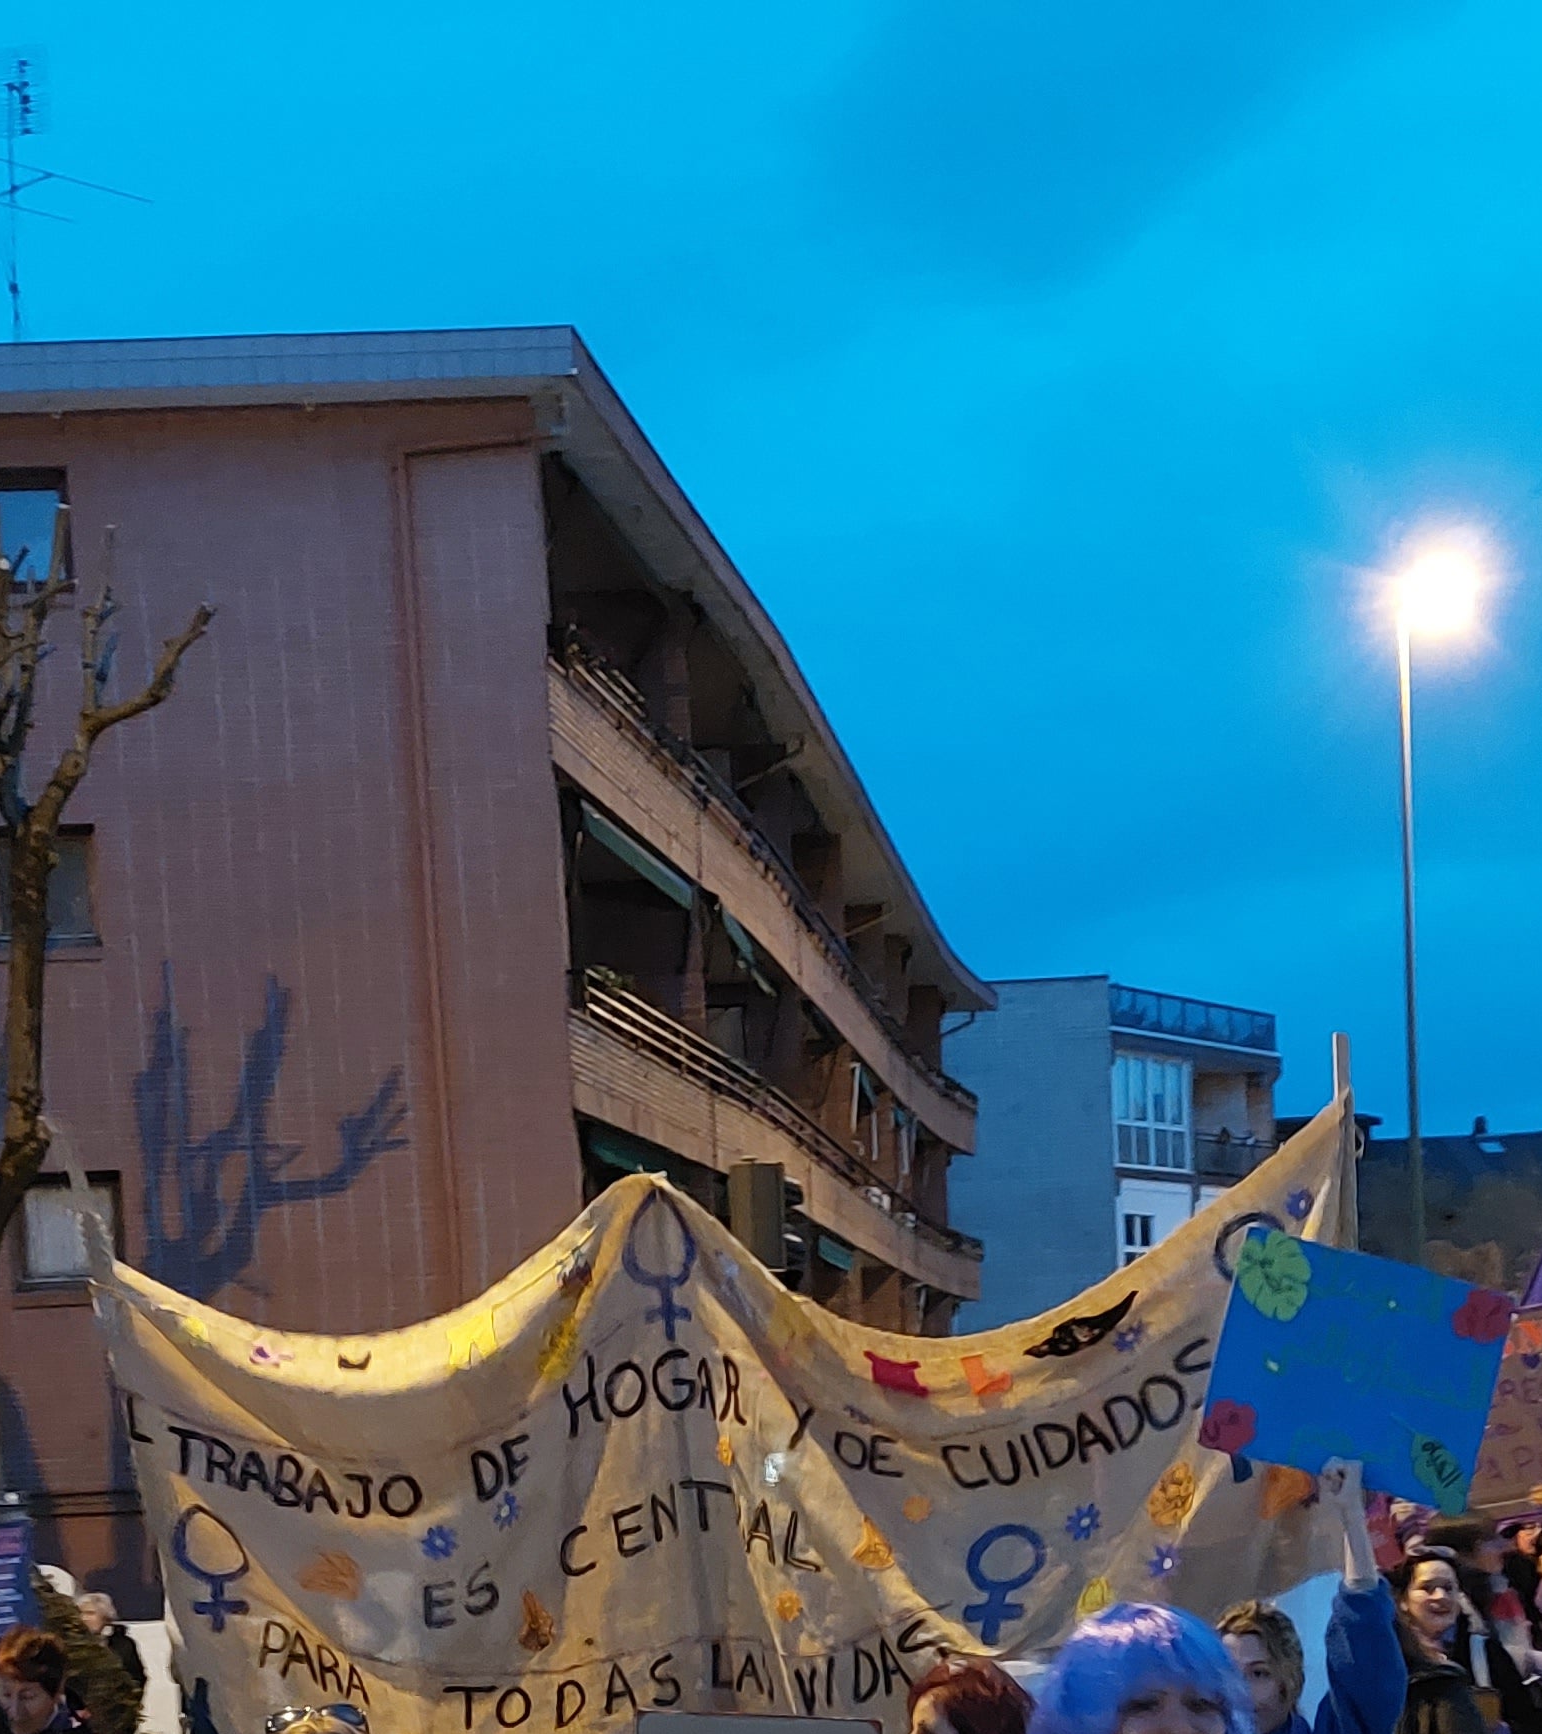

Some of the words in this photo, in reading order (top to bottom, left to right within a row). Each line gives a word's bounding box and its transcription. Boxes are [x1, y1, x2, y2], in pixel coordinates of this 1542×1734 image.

[126, 1392, 155, 1445] L
[168, 1425, 423, 1520] TRABAJO
[471, 1434, 530, 1503] DE
[563, 1348, 747, 1438] HOGAR
[785, 1402, 815, 1450] Y
[833, 1429, 904, 1479] DE
[423, 1572, 500, 1630] ES
[560, 1478, 821, 1578] CENTAL
[259, 1619, 369, 1705] PARA
[444, 1655, 683, 1731] TODAS
[711, 1640, 775, 1698] LA
